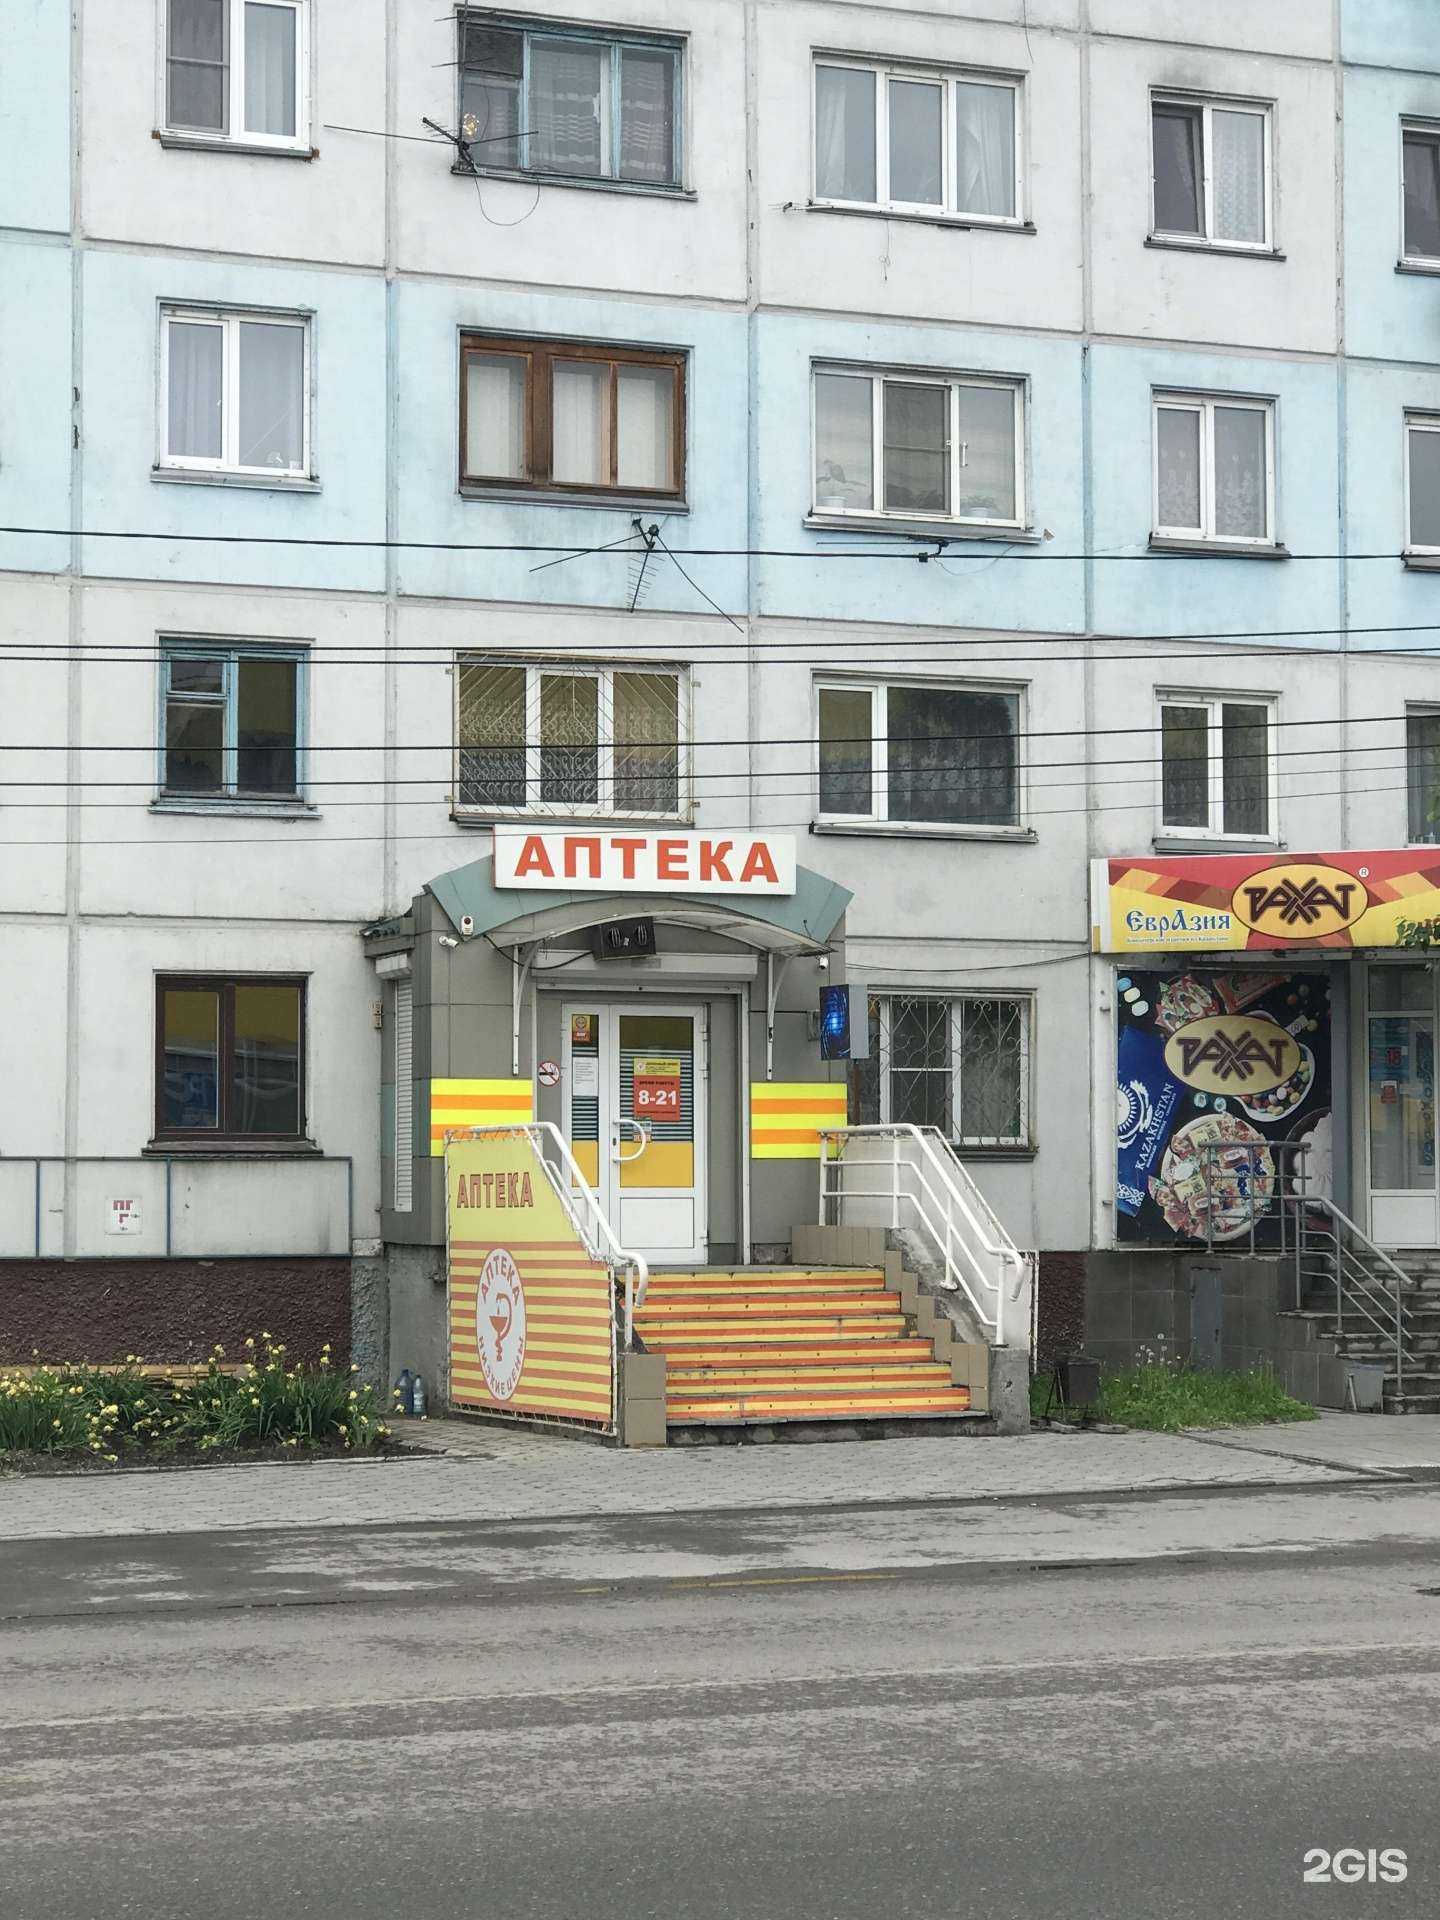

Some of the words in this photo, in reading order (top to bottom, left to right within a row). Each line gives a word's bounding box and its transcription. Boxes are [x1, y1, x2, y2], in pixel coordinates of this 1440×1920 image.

[514, 836, 779, 883] АПТЕКА
[638, 1089, 677, 1106] 8-21
[1135, 1083, 1175, 1170] KAZAKHSTAN
[456, 1171, 534, 1209] АПТЕКА
[481, 1255, 520, 1306] АПТЕКА
[478, 1335, 506, 1396] НИЗКИЕ
